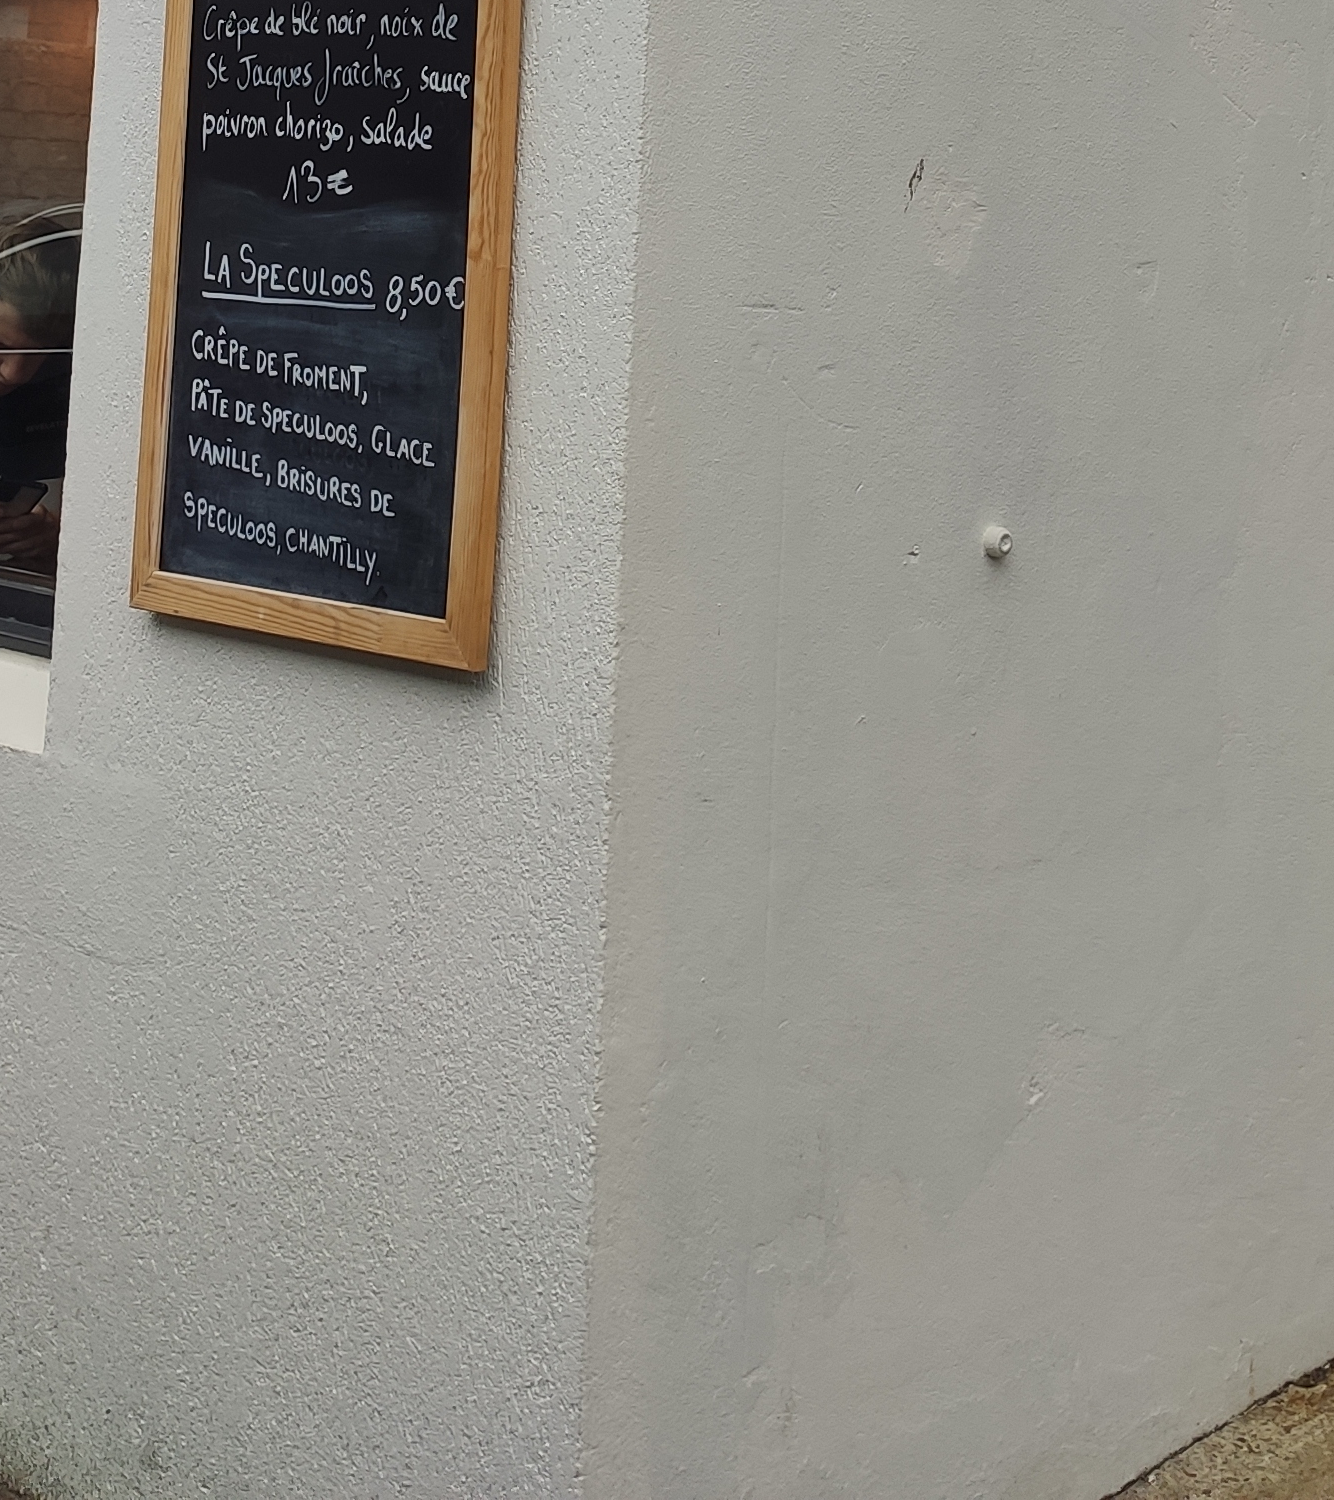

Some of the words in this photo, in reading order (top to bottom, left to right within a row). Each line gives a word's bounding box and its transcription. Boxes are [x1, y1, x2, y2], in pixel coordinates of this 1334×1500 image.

[203, 5, 260, 51] Crêpe
[265, 7, 285, 36] de
[292, 1, 320, 36] blé
[327, 9, 375, 50] noir,
[380, 7, 423, 37] noix
[432, 3, 459, 40] de
[207, 52, 229, 88] St
[237, 54, 312, 100] Jacques
[420, 66, 471, 99] sauce
[202, 109, 267, 151] poivron
[276, 101, 354, 152] chorizo,
[283, 160, 353, 203] 13€
[204, 241, 231, 288] LA
[240, 244, 374, 298] SPECULOOS
[386, 274, 465, 321] 8,50€
[192, 326, 250, 371] CRÊPE
[256, 350, 278, 376] DE
[284, 353, 368, 405] FROMENT,
[191, 378, 229, 418] PÂTE
[235, 403, 256, 425] DE
[262, 402, 363, 453] SPECULOOS,
[371, 425, 435, 467] GLACE
[277, 459, 362, 508] BRISURES
[370, 489, 395, 517] DE
[184, 492, 281, 556] SPECULOOS,
